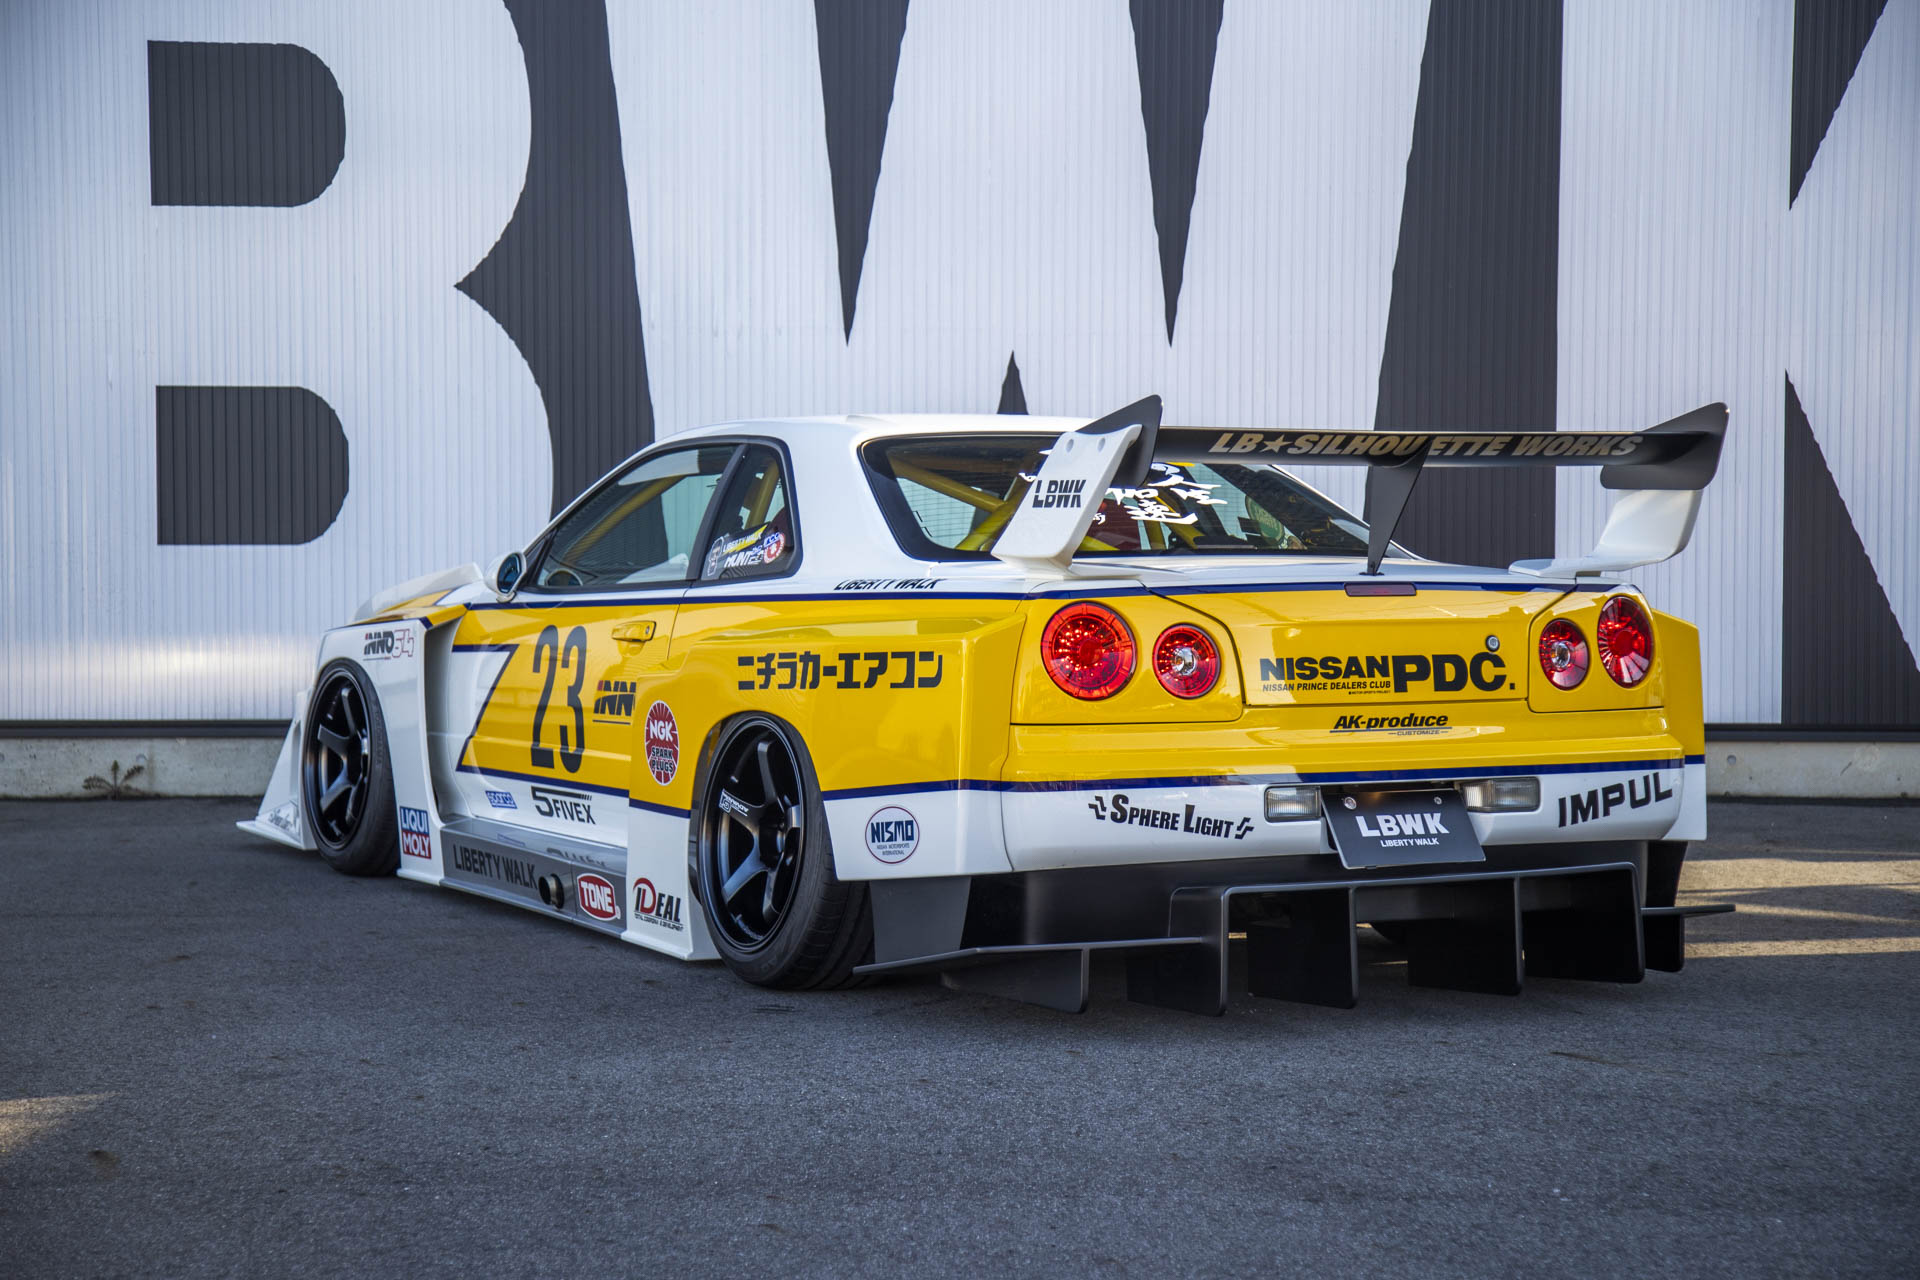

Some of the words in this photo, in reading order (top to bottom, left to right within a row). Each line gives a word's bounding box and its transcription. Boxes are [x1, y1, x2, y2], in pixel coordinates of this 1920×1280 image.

[1511, 436, 1643, 457] WORKS
[1032, 479, 1087, 508] LBWK
[737, 650, 943, 691] ニチラカーエアコン
[1259, 655, 1390, 681] NISSAN
[531, 624, 587, 773] 23
[1262, 683, 1295, 692] NISSAN
[1297, 682, 1328, 691] PRINCE
[1330, 681, 1368, 690] DEALERS
[1369, 680, 1391, 689] CLUB
[649, 719, 673, 742] NGK
[1333, 713, 1449, 730] AK-produce
[652, 745, 674, 760] SPARK
[652, 760, 674, 774] PLUGS
[1557, 771, 1673, 828] IMPUL
[400, 808, 429, 833] LIQUI
[870, 819, 915, 844] NISMO
[1355, 812, 1450, 837] LBWK
[402, 831, 431, 858] MOLY
[1380, 839, 1415, 848] LIBERTY
[1414, 837, 1440, 846] WALK
[452, 844, 500, 878] LIBERTY
[501, 855, 538, 890] WALK
[580, 880, 615, 914] TONE
[633, 877, 682, 923] IDEAL
